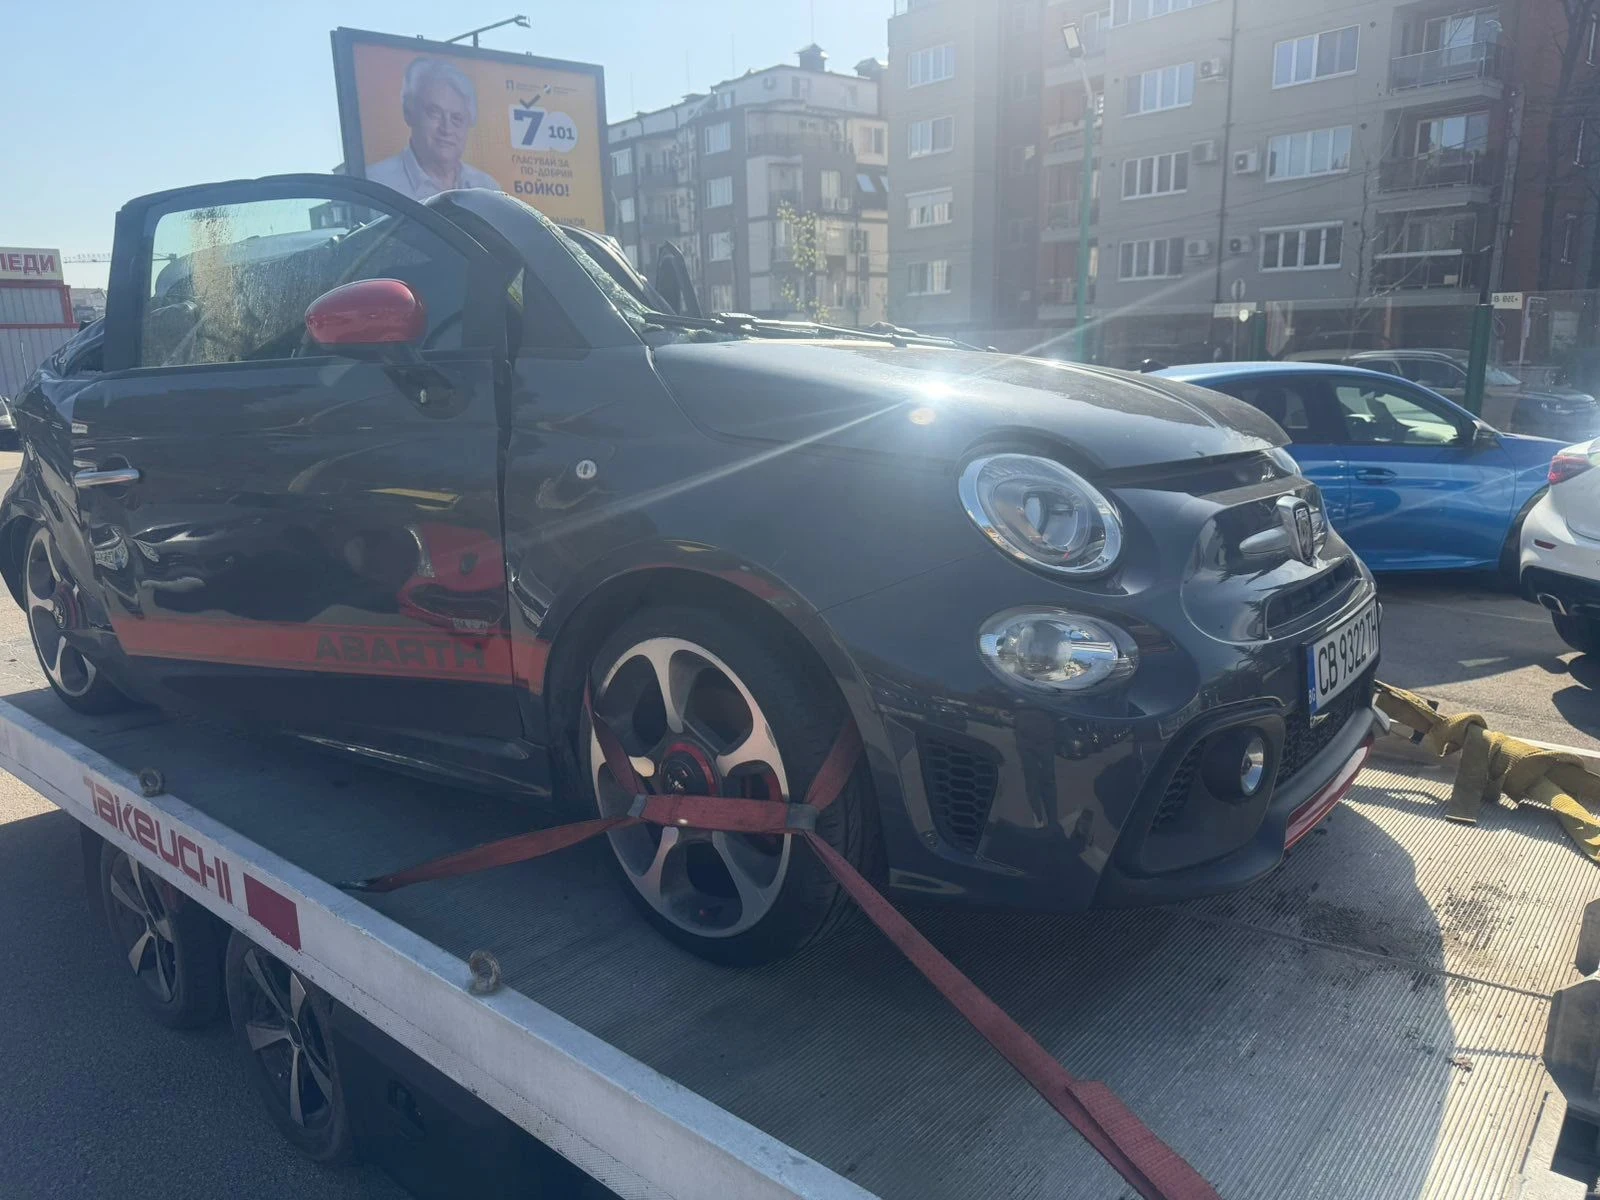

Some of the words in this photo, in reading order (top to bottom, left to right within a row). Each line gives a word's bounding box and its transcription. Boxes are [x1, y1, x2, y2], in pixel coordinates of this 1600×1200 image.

[513, 109, 545, 146] 7
[548, 125, 575, 141] 101
[514, 178, 569, 197] БОЙКО!
[314, 634, 487, 669] ABARTH
[1317, 641, 1338, 696] CB
[1339, 621, 1366, 680] 9322
[1366, 606, 1378, 656] TH
[1308, 689, 1316, 705] BG
